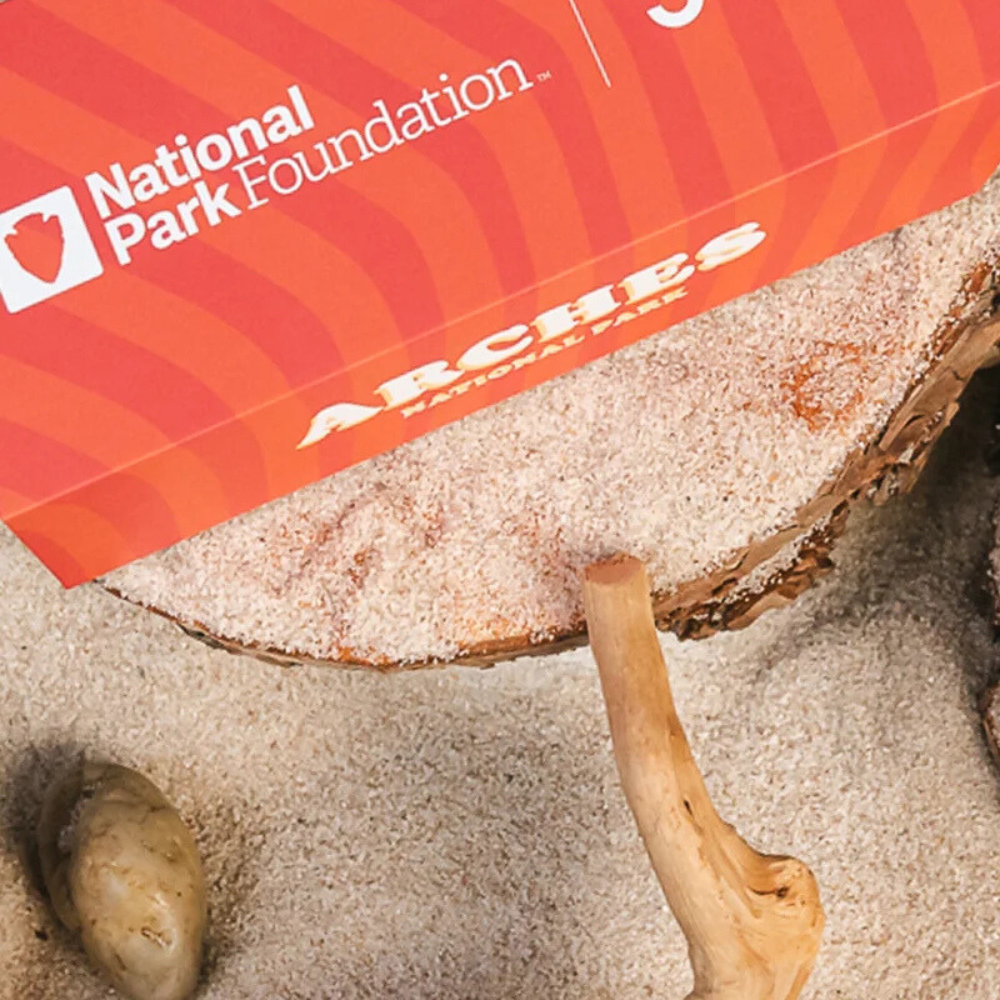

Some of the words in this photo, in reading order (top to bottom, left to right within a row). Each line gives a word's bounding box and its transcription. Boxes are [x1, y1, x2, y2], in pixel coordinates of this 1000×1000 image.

[84, 85, 315, 220] National
[101, 180, 242, 266] Park
[232, 58, 535, 210] Foundation
[295, 221, 767, 451] ARCHES
[400, 333, 586, 419] NATIONAL
[592, 286, 690, 336] PARK
